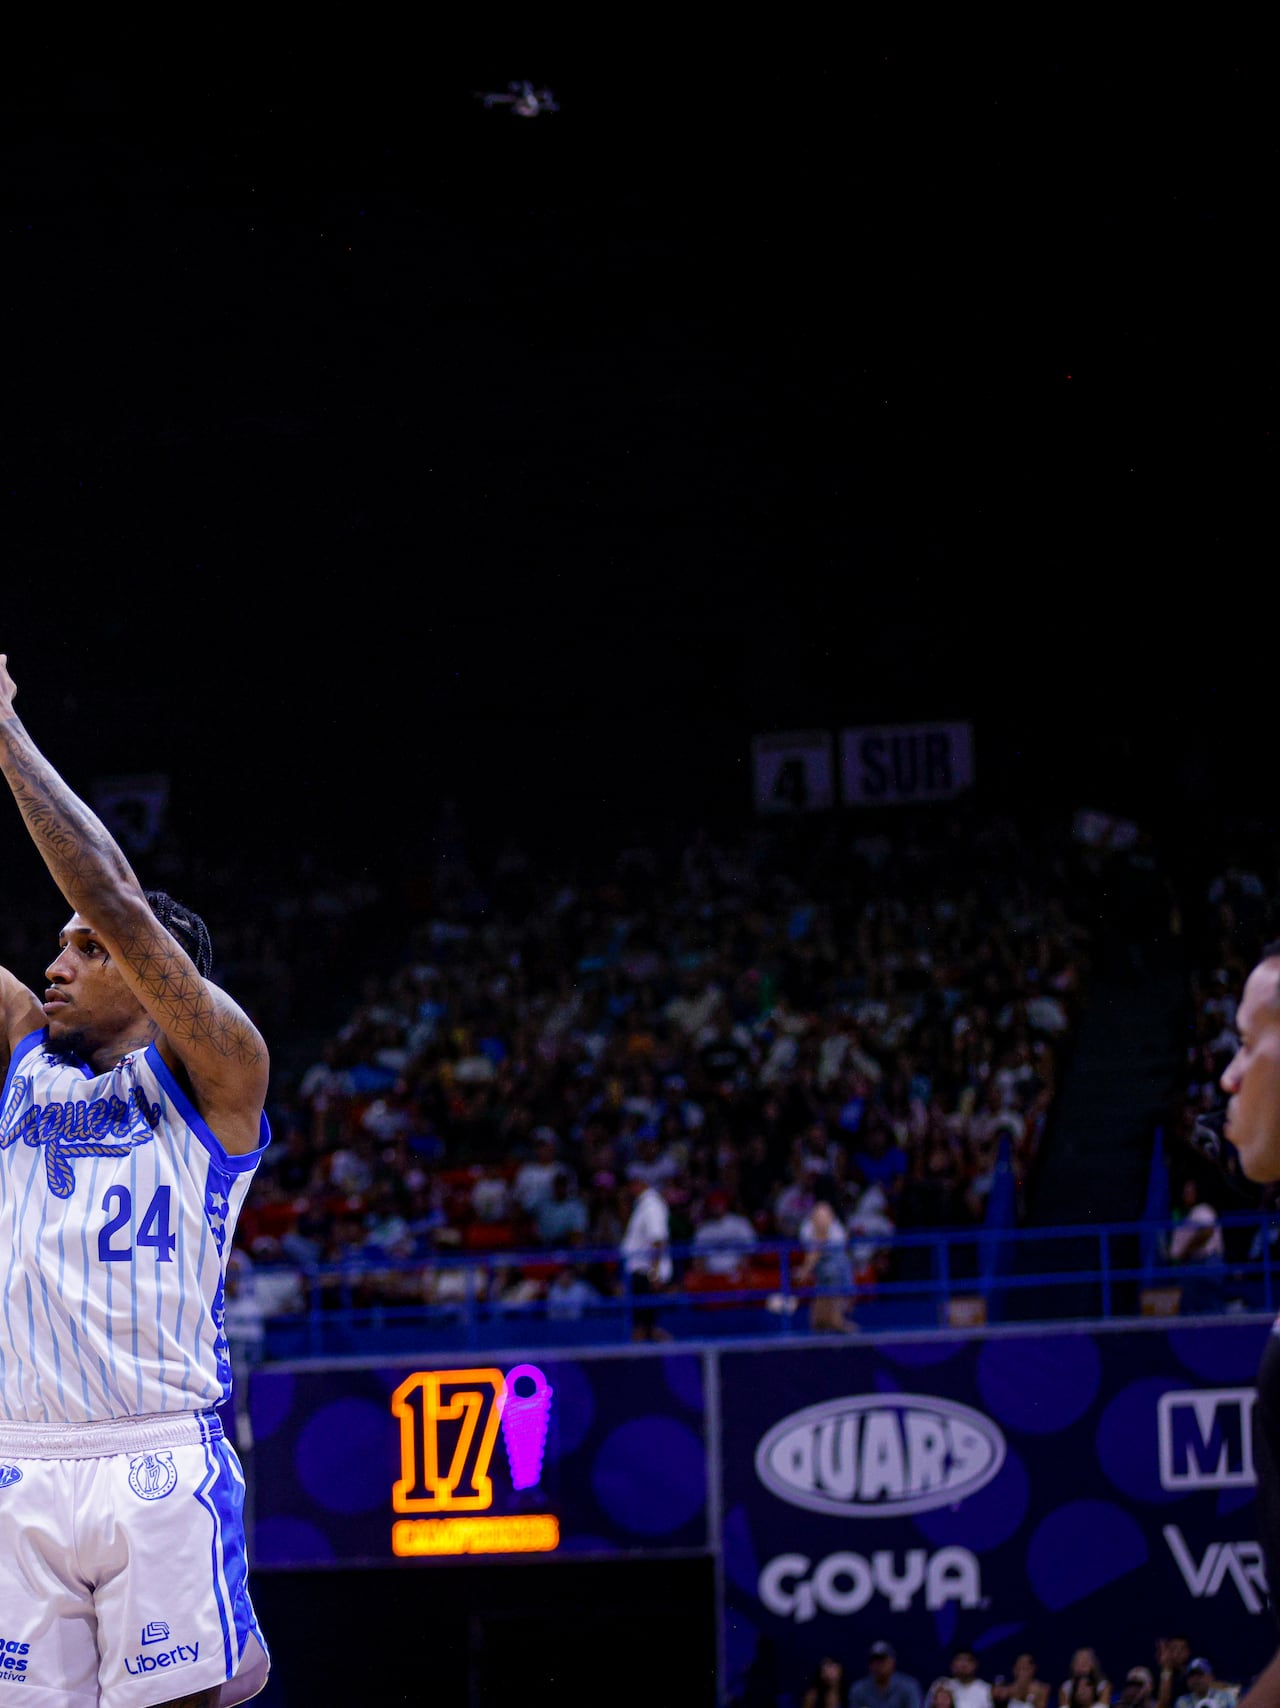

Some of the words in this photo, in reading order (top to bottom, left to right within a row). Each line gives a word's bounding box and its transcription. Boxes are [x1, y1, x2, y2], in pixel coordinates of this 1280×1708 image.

[775, 761, 806, 806] 4
[862, 733, 953, 795] SUR
[98, 1184, 176, 1263] 24
[391, 1368, 507, 1514] 17
[756, 1545, 983, 1625] GOYA
[124, 1641, 199, 1675] Liberty
